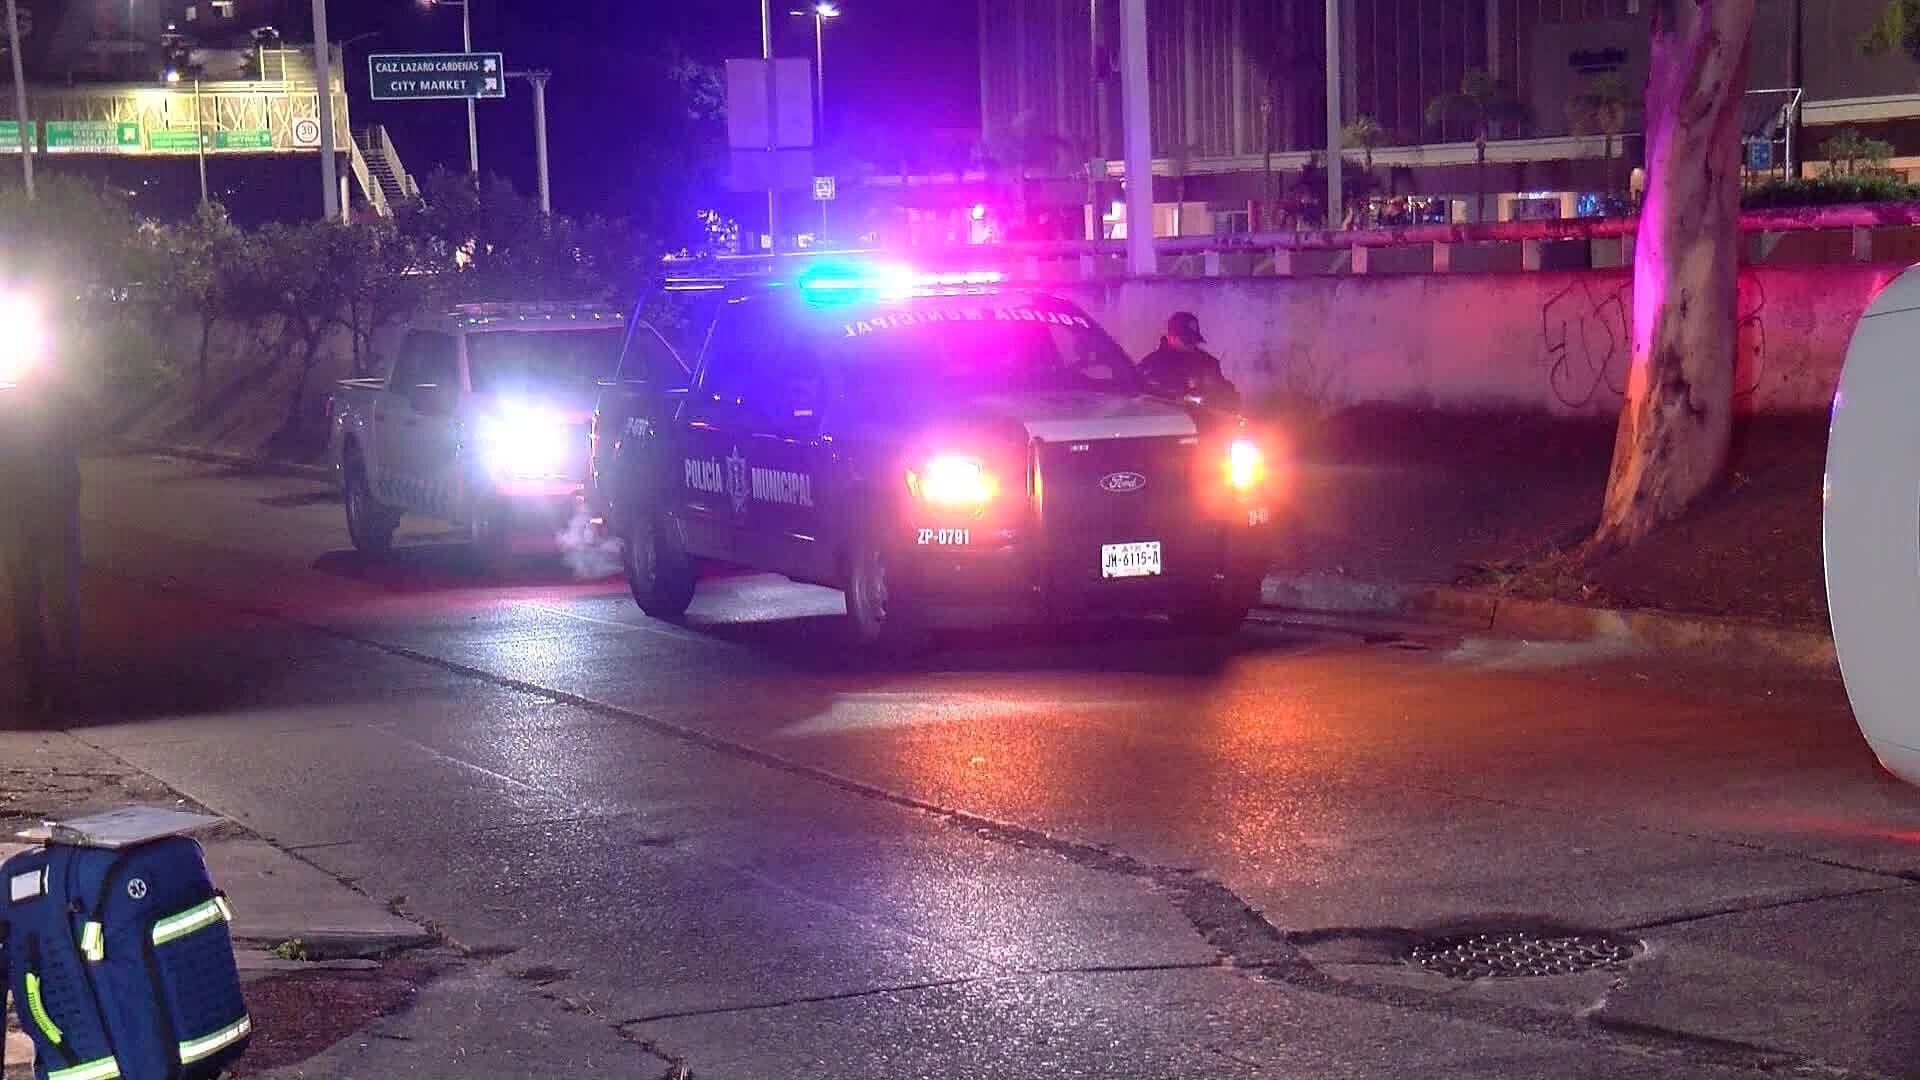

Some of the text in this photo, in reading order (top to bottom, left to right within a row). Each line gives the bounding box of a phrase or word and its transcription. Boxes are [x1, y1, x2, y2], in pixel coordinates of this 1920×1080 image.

[436, 61, 479, 72] CARDENAS
[391, 79, 467, 91] CITY MARKET
[301, 124, 313, 136] 30
[751, 467, 814, 507] MUNICIPAL
[1109, 474, 1137, 489] Ford
[917, 527, 970, 545] ZP-0791
[1105, 551, 1159, 568] JM-6115-A
